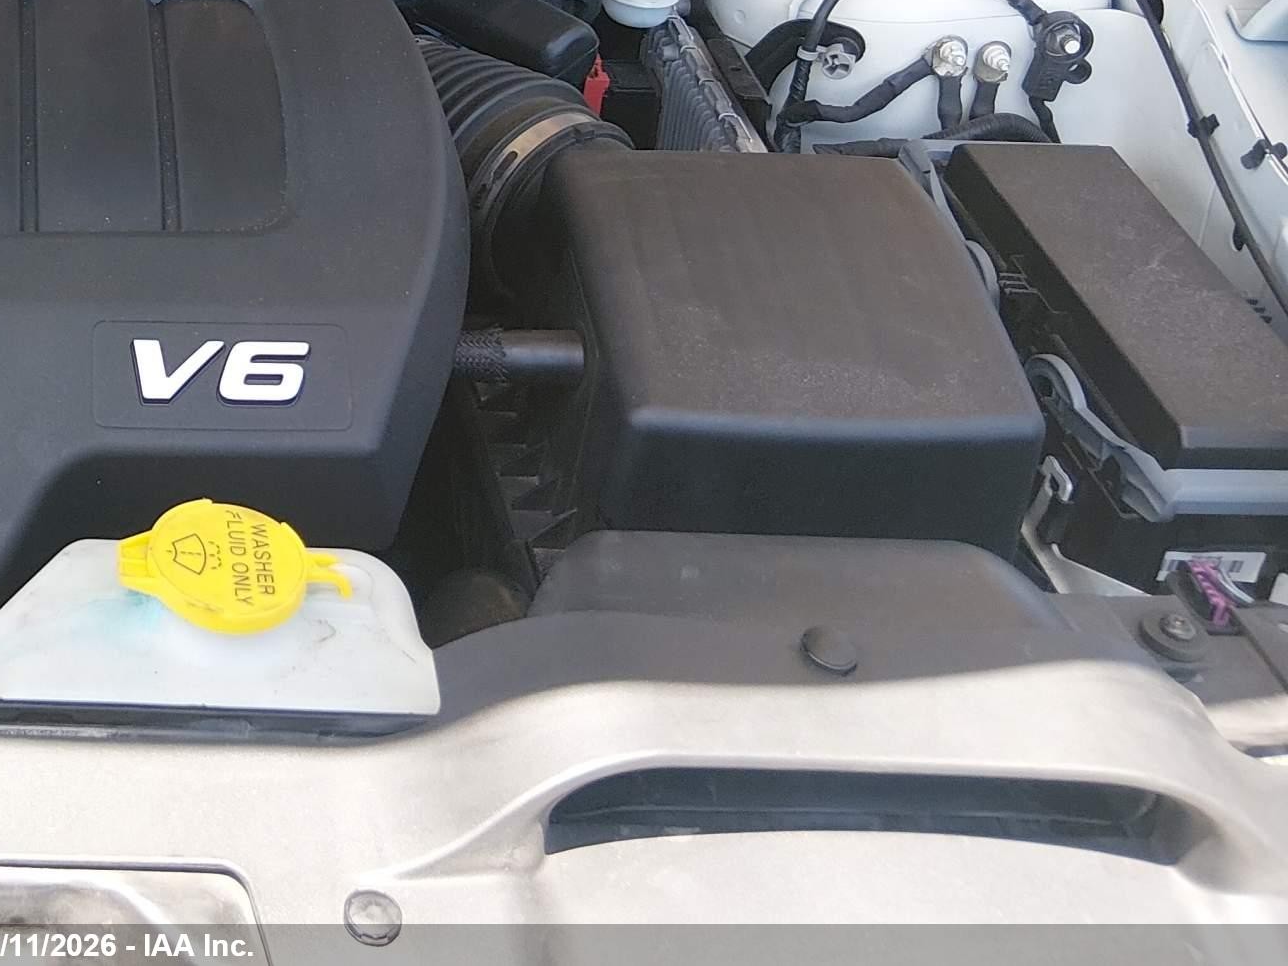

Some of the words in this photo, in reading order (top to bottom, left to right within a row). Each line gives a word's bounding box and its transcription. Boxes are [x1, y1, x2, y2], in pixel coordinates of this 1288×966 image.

[131, 338, 311, 405] V6
[225, 510, 246, 556] FLUID
[250, 523, 275, 596] WASHER
[231, 562, 253, 607] ONLY
